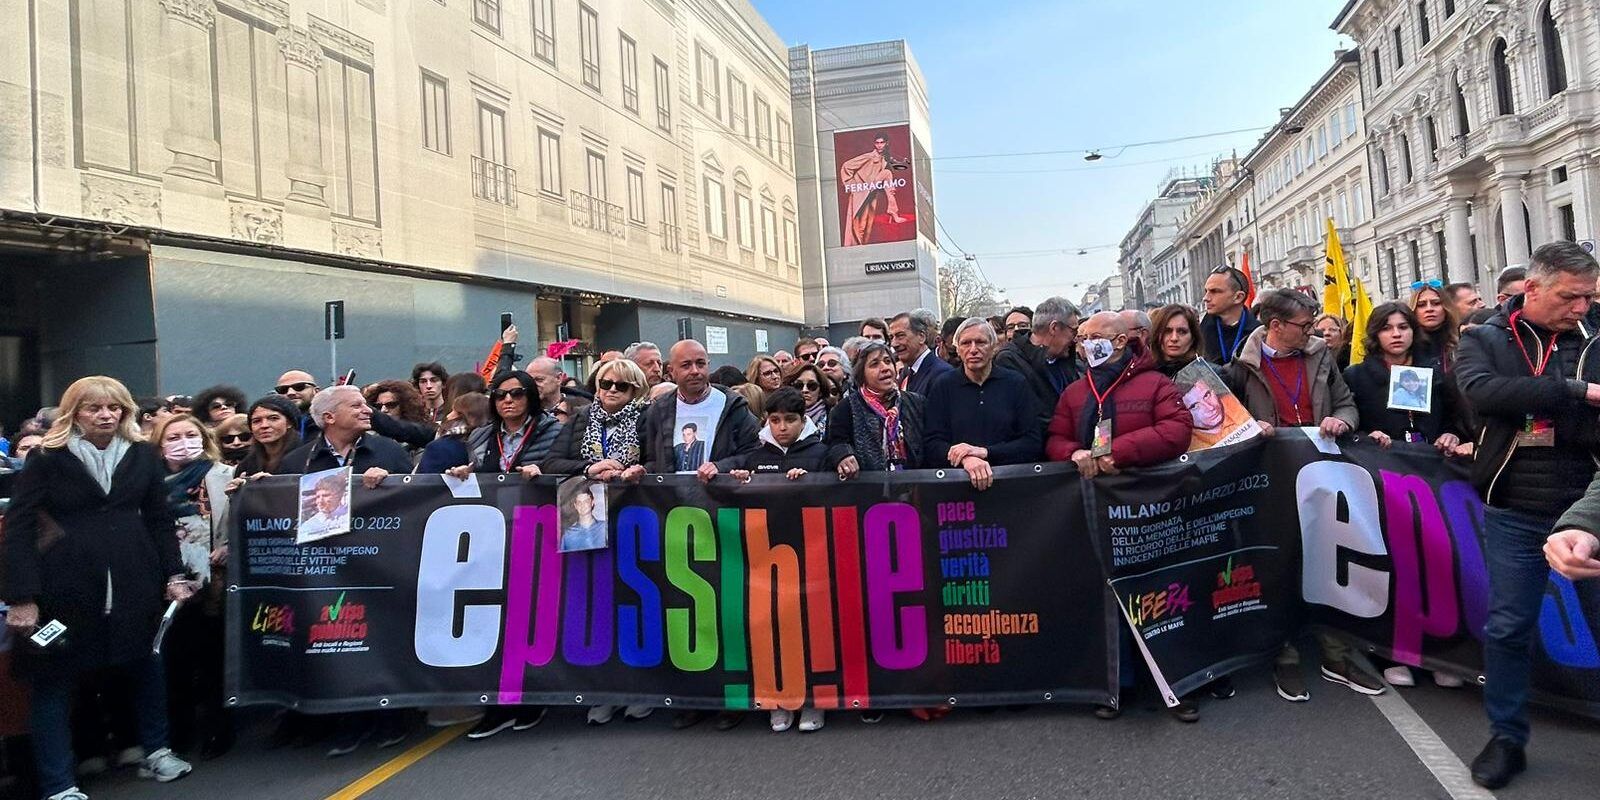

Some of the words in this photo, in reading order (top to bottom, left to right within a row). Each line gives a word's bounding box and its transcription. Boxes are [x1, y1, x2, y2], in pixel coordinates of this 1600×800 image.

[845, 178, 906, 193] FERRAGAMO
[866, 264, 890, 273] URBAN
[891, 261, 914, 270] VISION
[1223, 423, 1253, 446] PASQUALE
[1108, 502, 1170, 519] MILANO
[1174, 497, 1186, 511] 21
[1191, 483, 1235, 506] MARZO
[1237, 475, 1269, 491] 2023
[246, 517, 291, 531] MILANO
[368, 516, 401, 530] 2023
[937, 501, 976, 526] pace
[1110, 526, 1139, 536] XXVIII
[1140, 515, 1183, 534] GIORNATA
[1112, 536, 1144, 546] DELLA
[1145, 524, 1185, 542] MEMORIA
[1186, 521, 1192, 530] E
[1193, 506, 1254, 528] DELL'IMPEGNO
[302, 547, 309, 556] E
[311, 546, 378, 555] DELL'IMPEGNO
[939, 524, 1008, 554] giustizia
[1112, 547, 1123, 556] IN
[1125, 540, 1164, 556] RICORDO
[1165, 530, 1191, 546] DELLE
[1193, 521, 1227, 536] VITTIME
[1113, 549, 1162, 566] INNOCENTI
[1163, 540, 1191, 555] DELLE
[1191, 532, 1220, 547] MAFIE
[304, 566, 335, 575] MAFIE
[309, 556, 346, 565] VITTIME
[940, 553, 990, 578] verità
[942, 580, 990, 606] diritti
[944, 610, 1039, 639] accoglienza
[945, 639, 1001, 664] libertà
